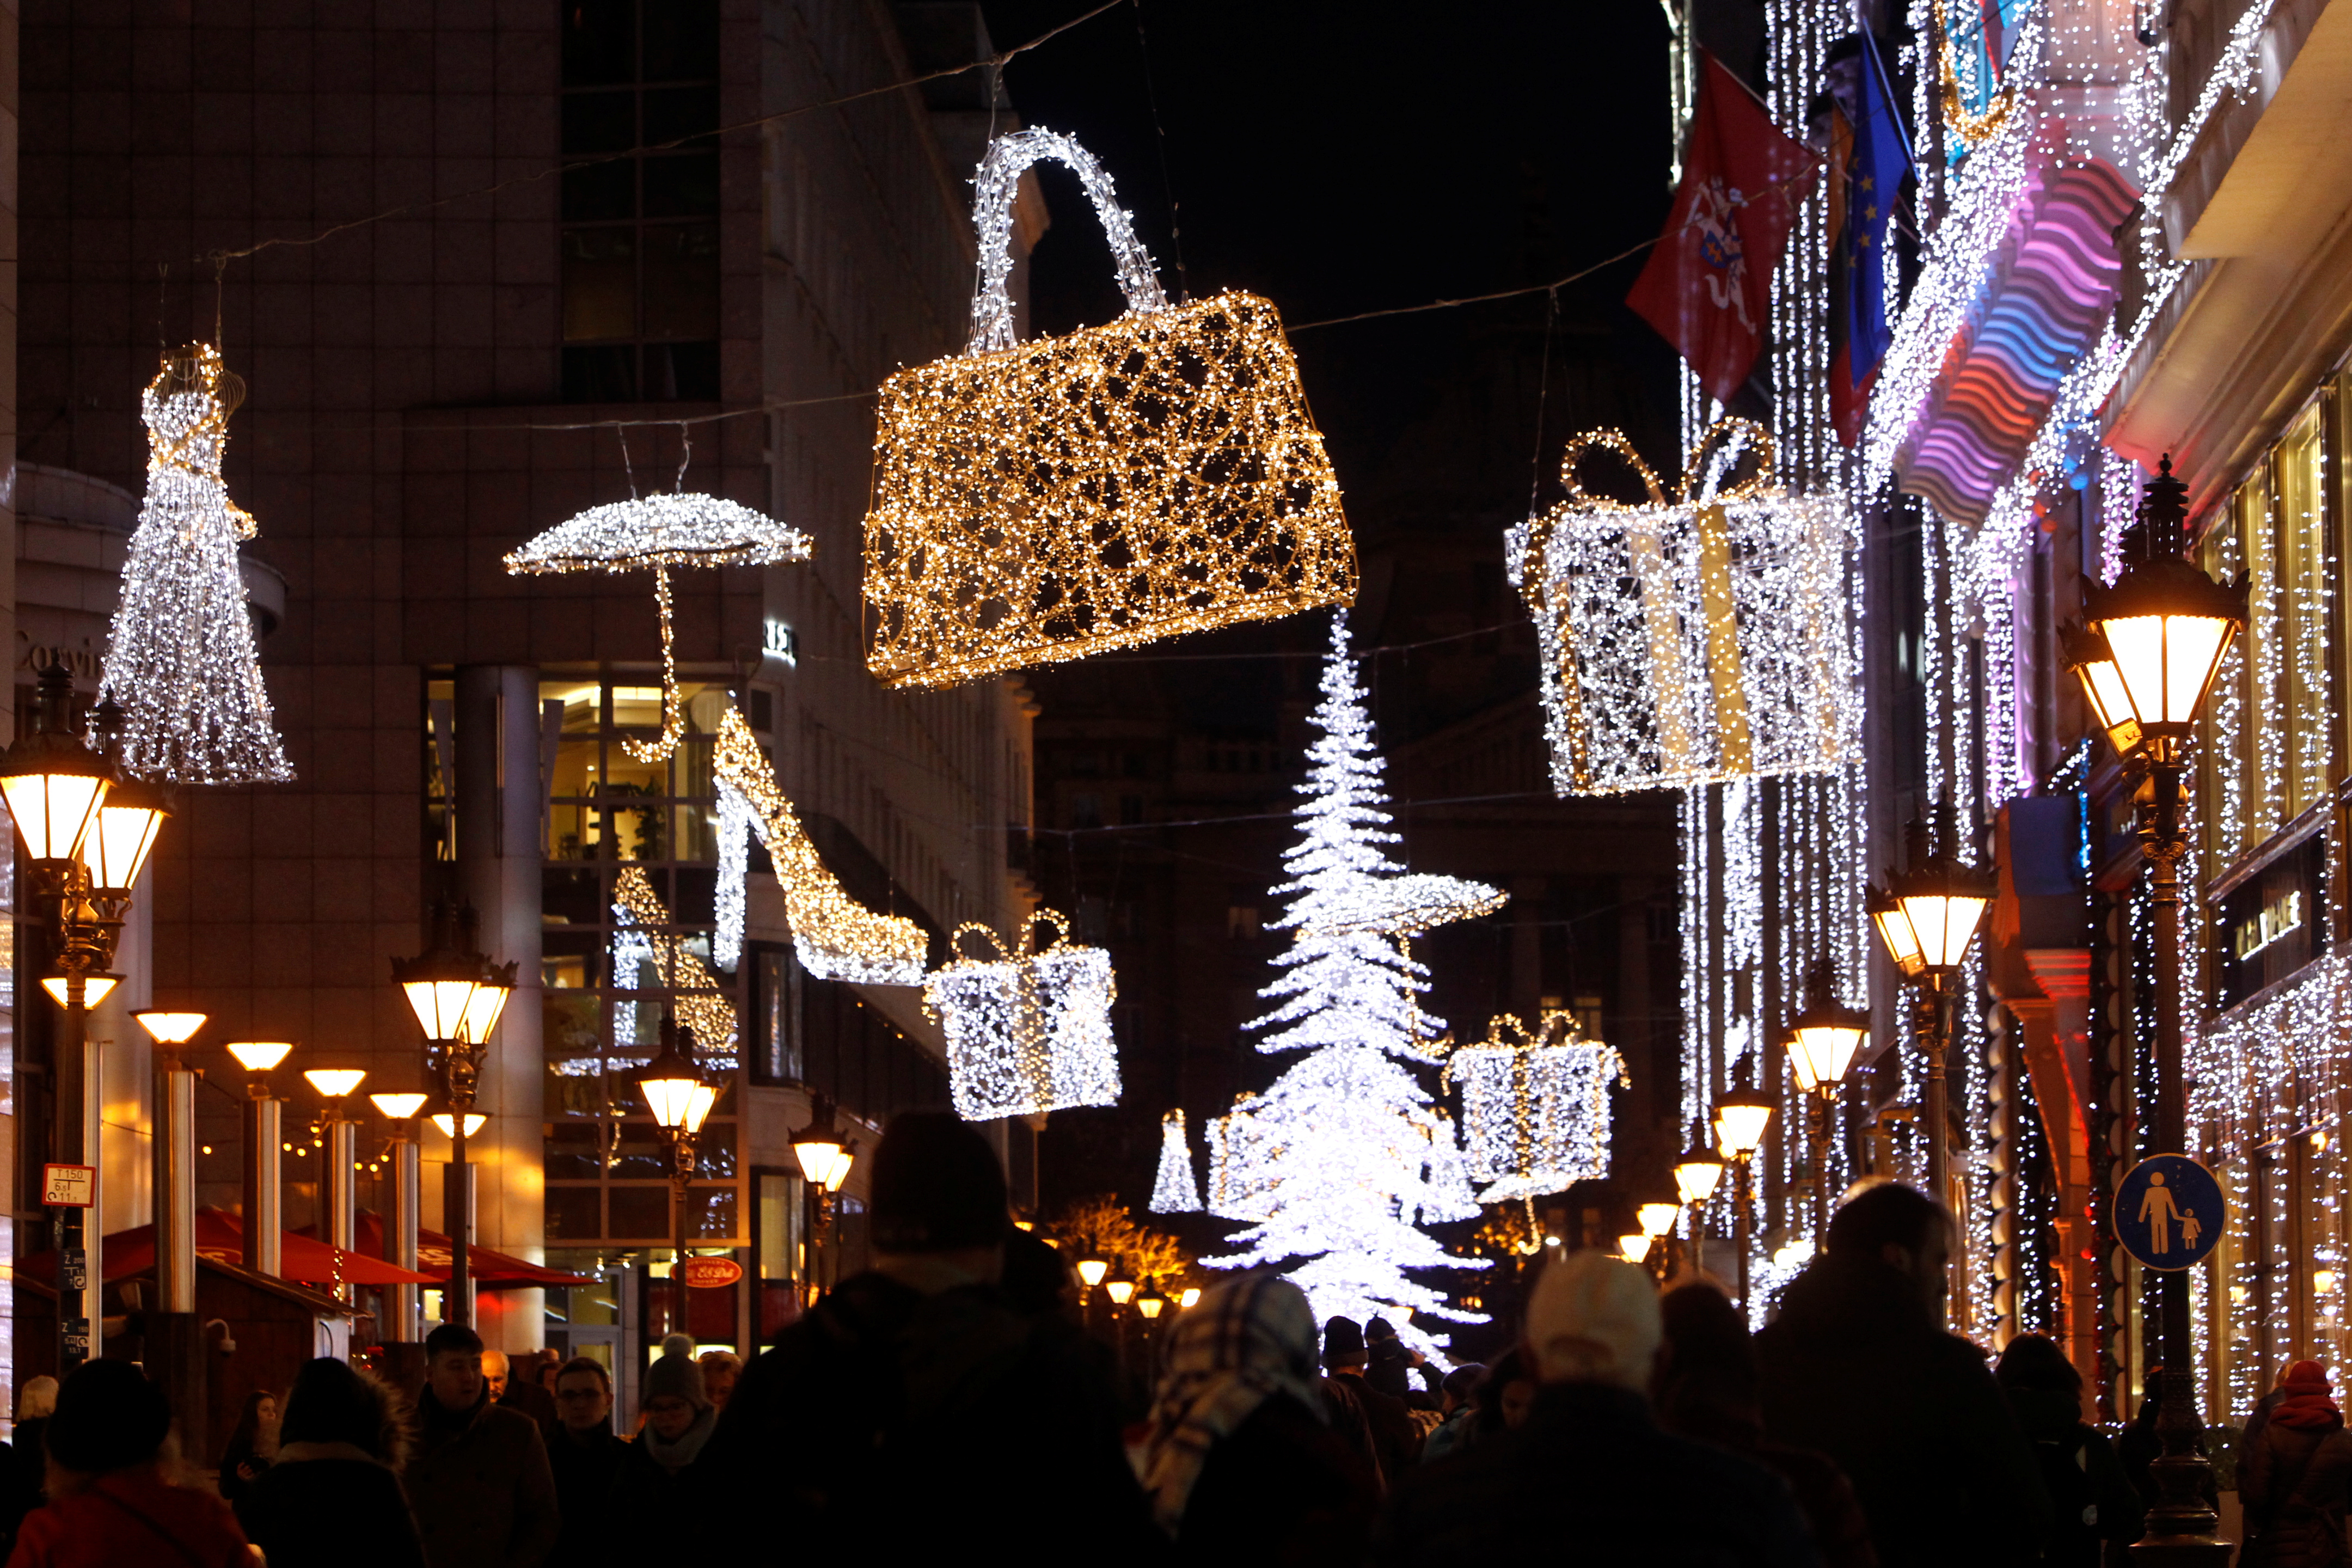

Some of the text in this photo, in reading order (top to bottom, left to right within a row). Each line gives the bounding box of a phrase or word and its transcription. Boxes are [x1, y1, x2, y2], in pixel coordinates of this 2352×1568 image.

[57, 1169, 83, 1179] T 150
[64, 1254, 71, 1264] Z
[61, 1322, 69, 1333] Z
